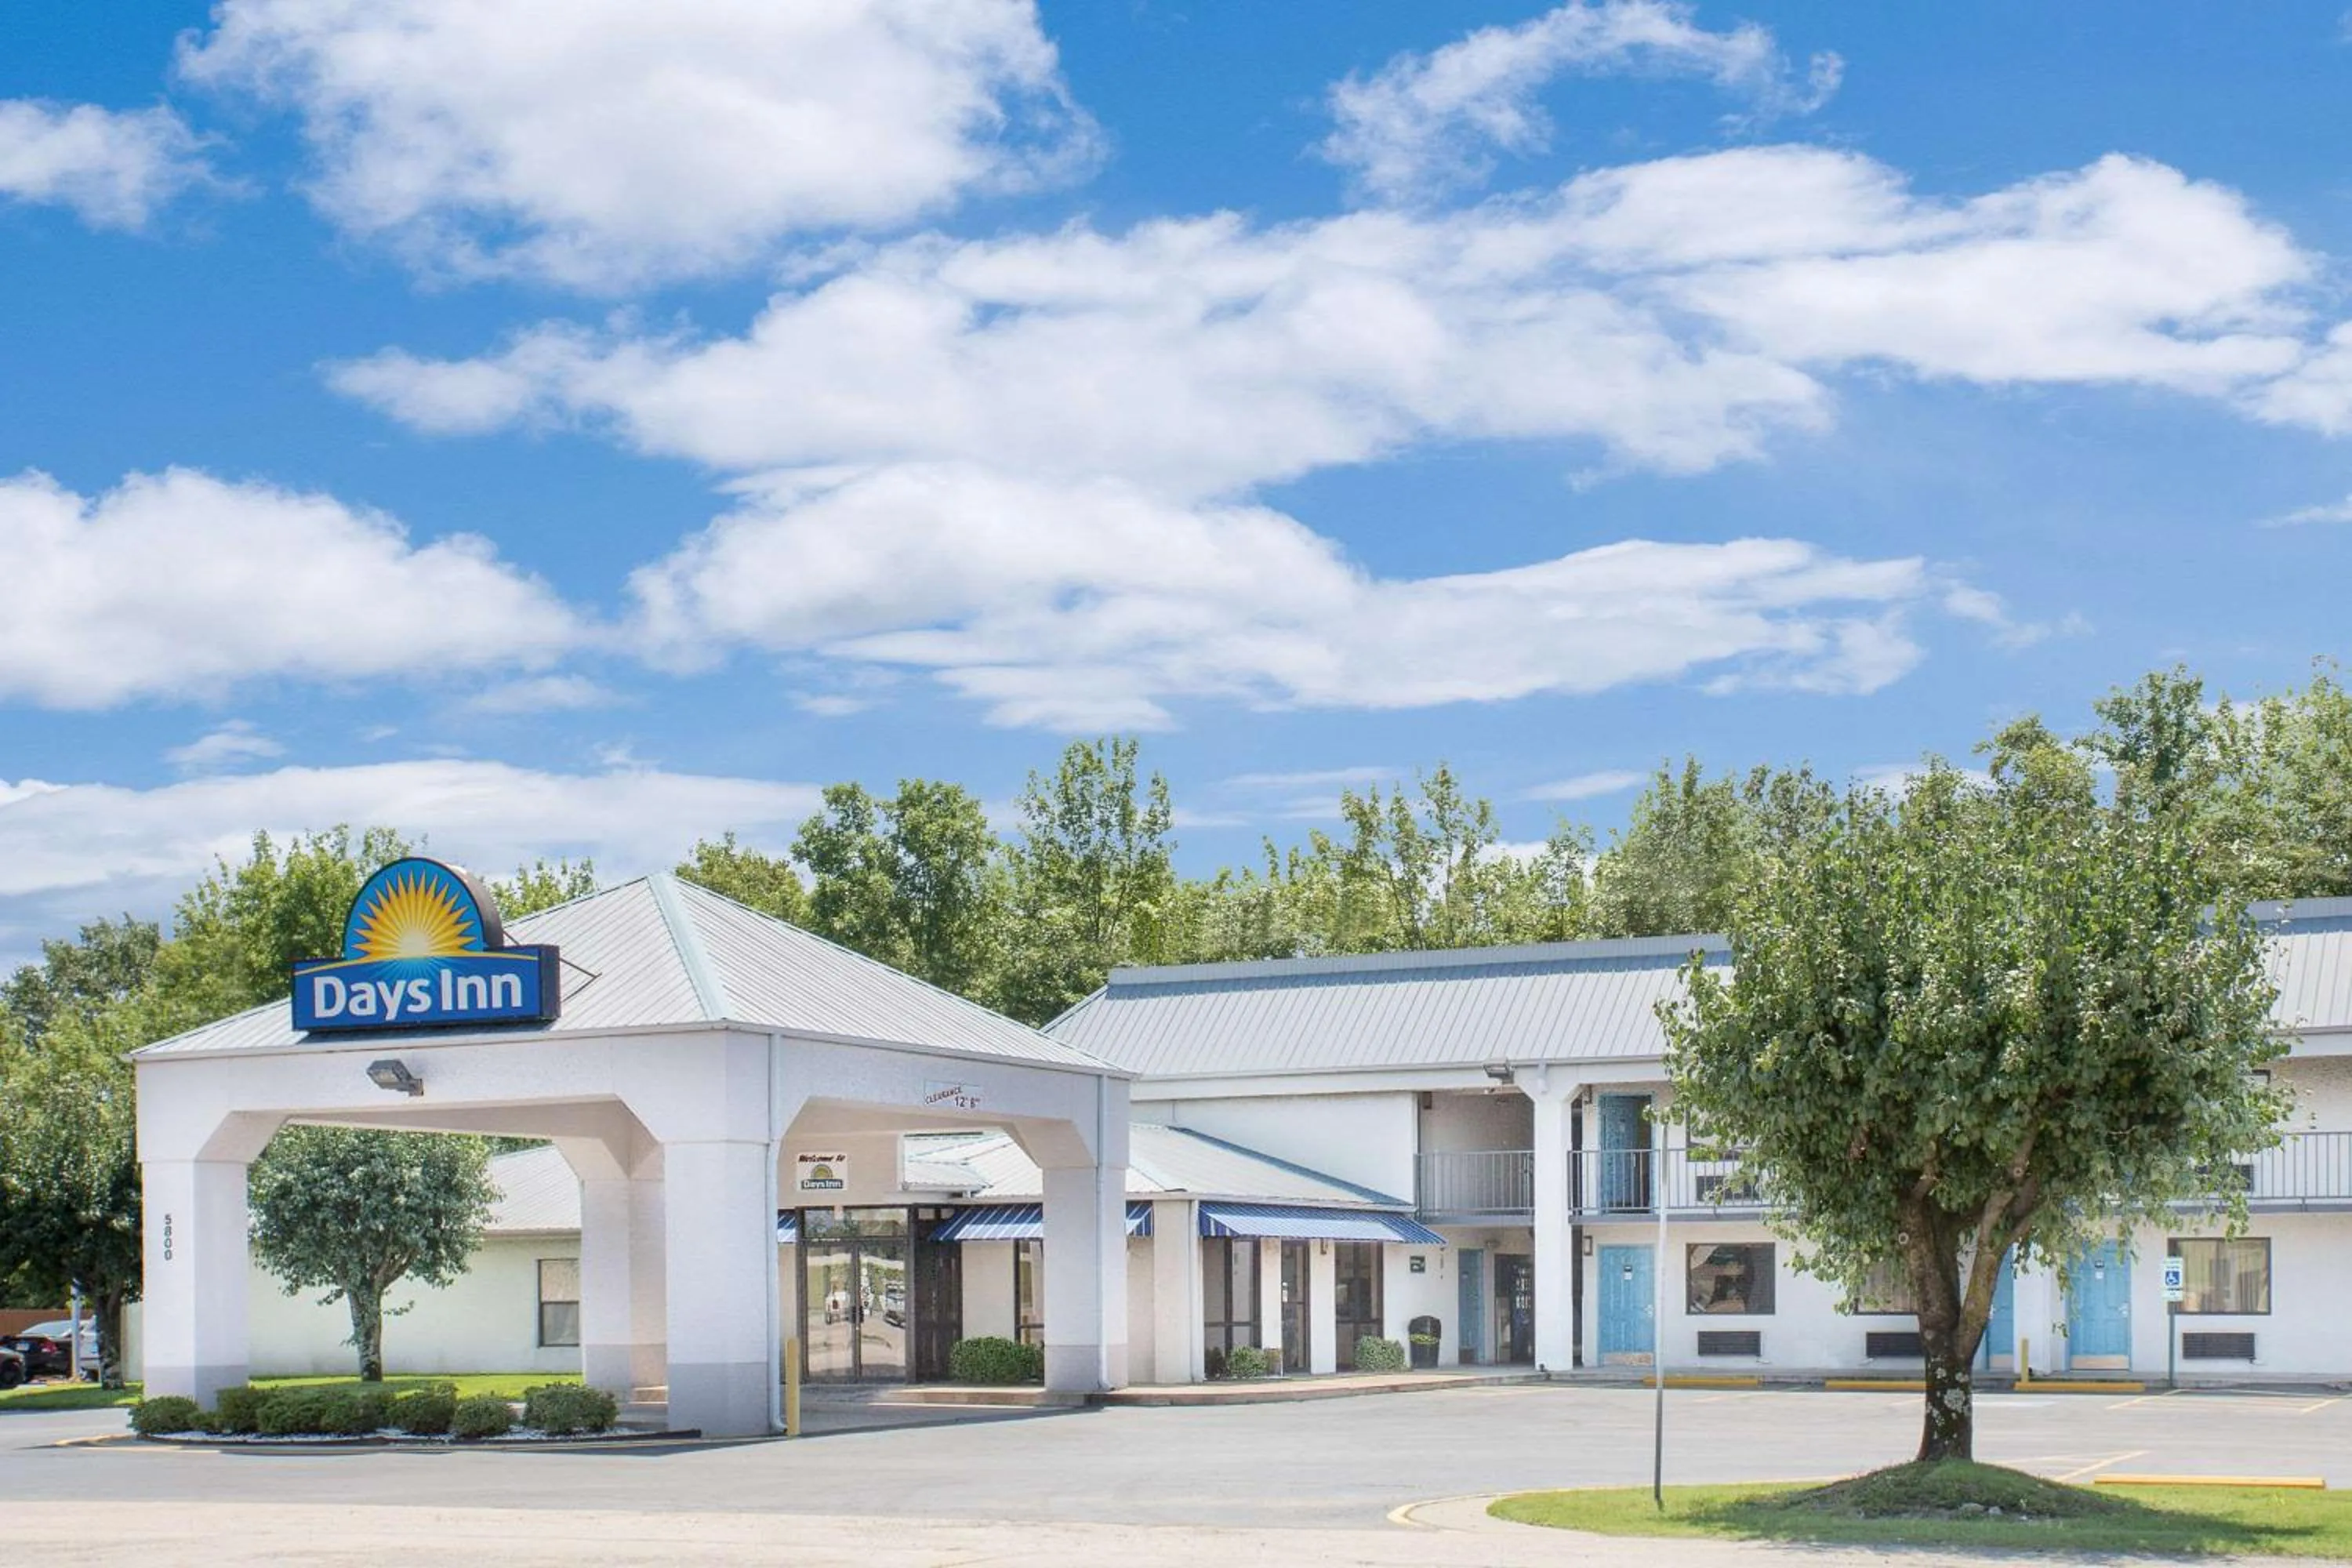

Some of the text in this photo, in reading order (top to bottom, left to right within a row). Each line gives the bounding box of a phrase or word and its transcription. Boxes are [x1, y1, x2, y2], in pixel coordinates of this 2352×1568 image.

[314, 969, 522, 1020] Days Inn
[925, 1086, 962, 1104] CLEARANCE
[804, 1180, 825, 1189] Days
[164, 1214, 172, 1261] 5800
